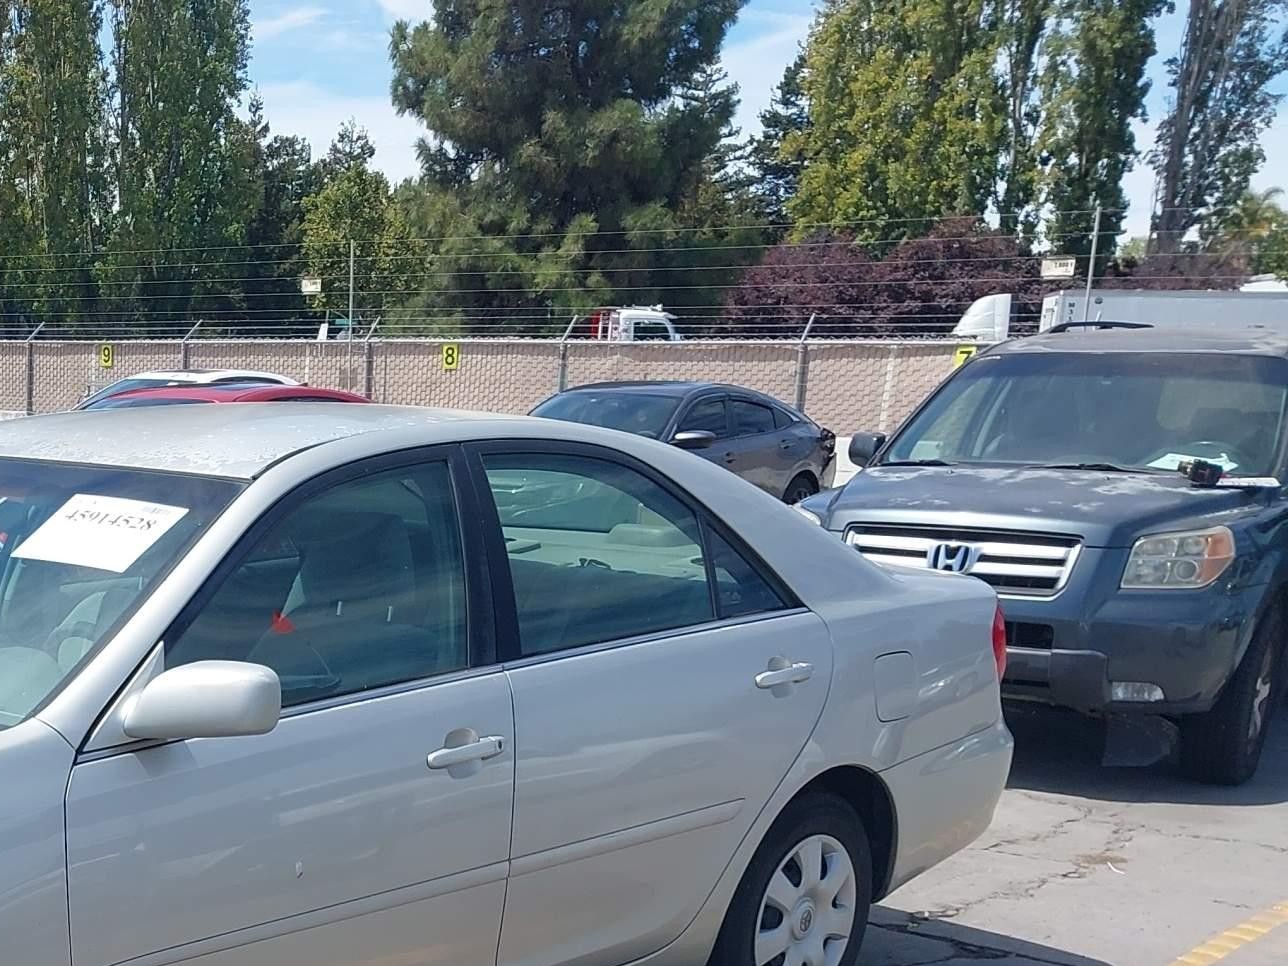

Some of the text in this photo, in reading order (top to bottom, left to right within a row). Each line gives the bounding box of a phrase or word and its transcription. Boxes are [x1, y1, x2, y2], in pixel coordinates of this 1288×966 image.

[103, 346, 110, 363] 9
[445, 346, 455, 365] 8
[959, 350, 973, 366] 7
[65, 509, 158, 531] 45914528
